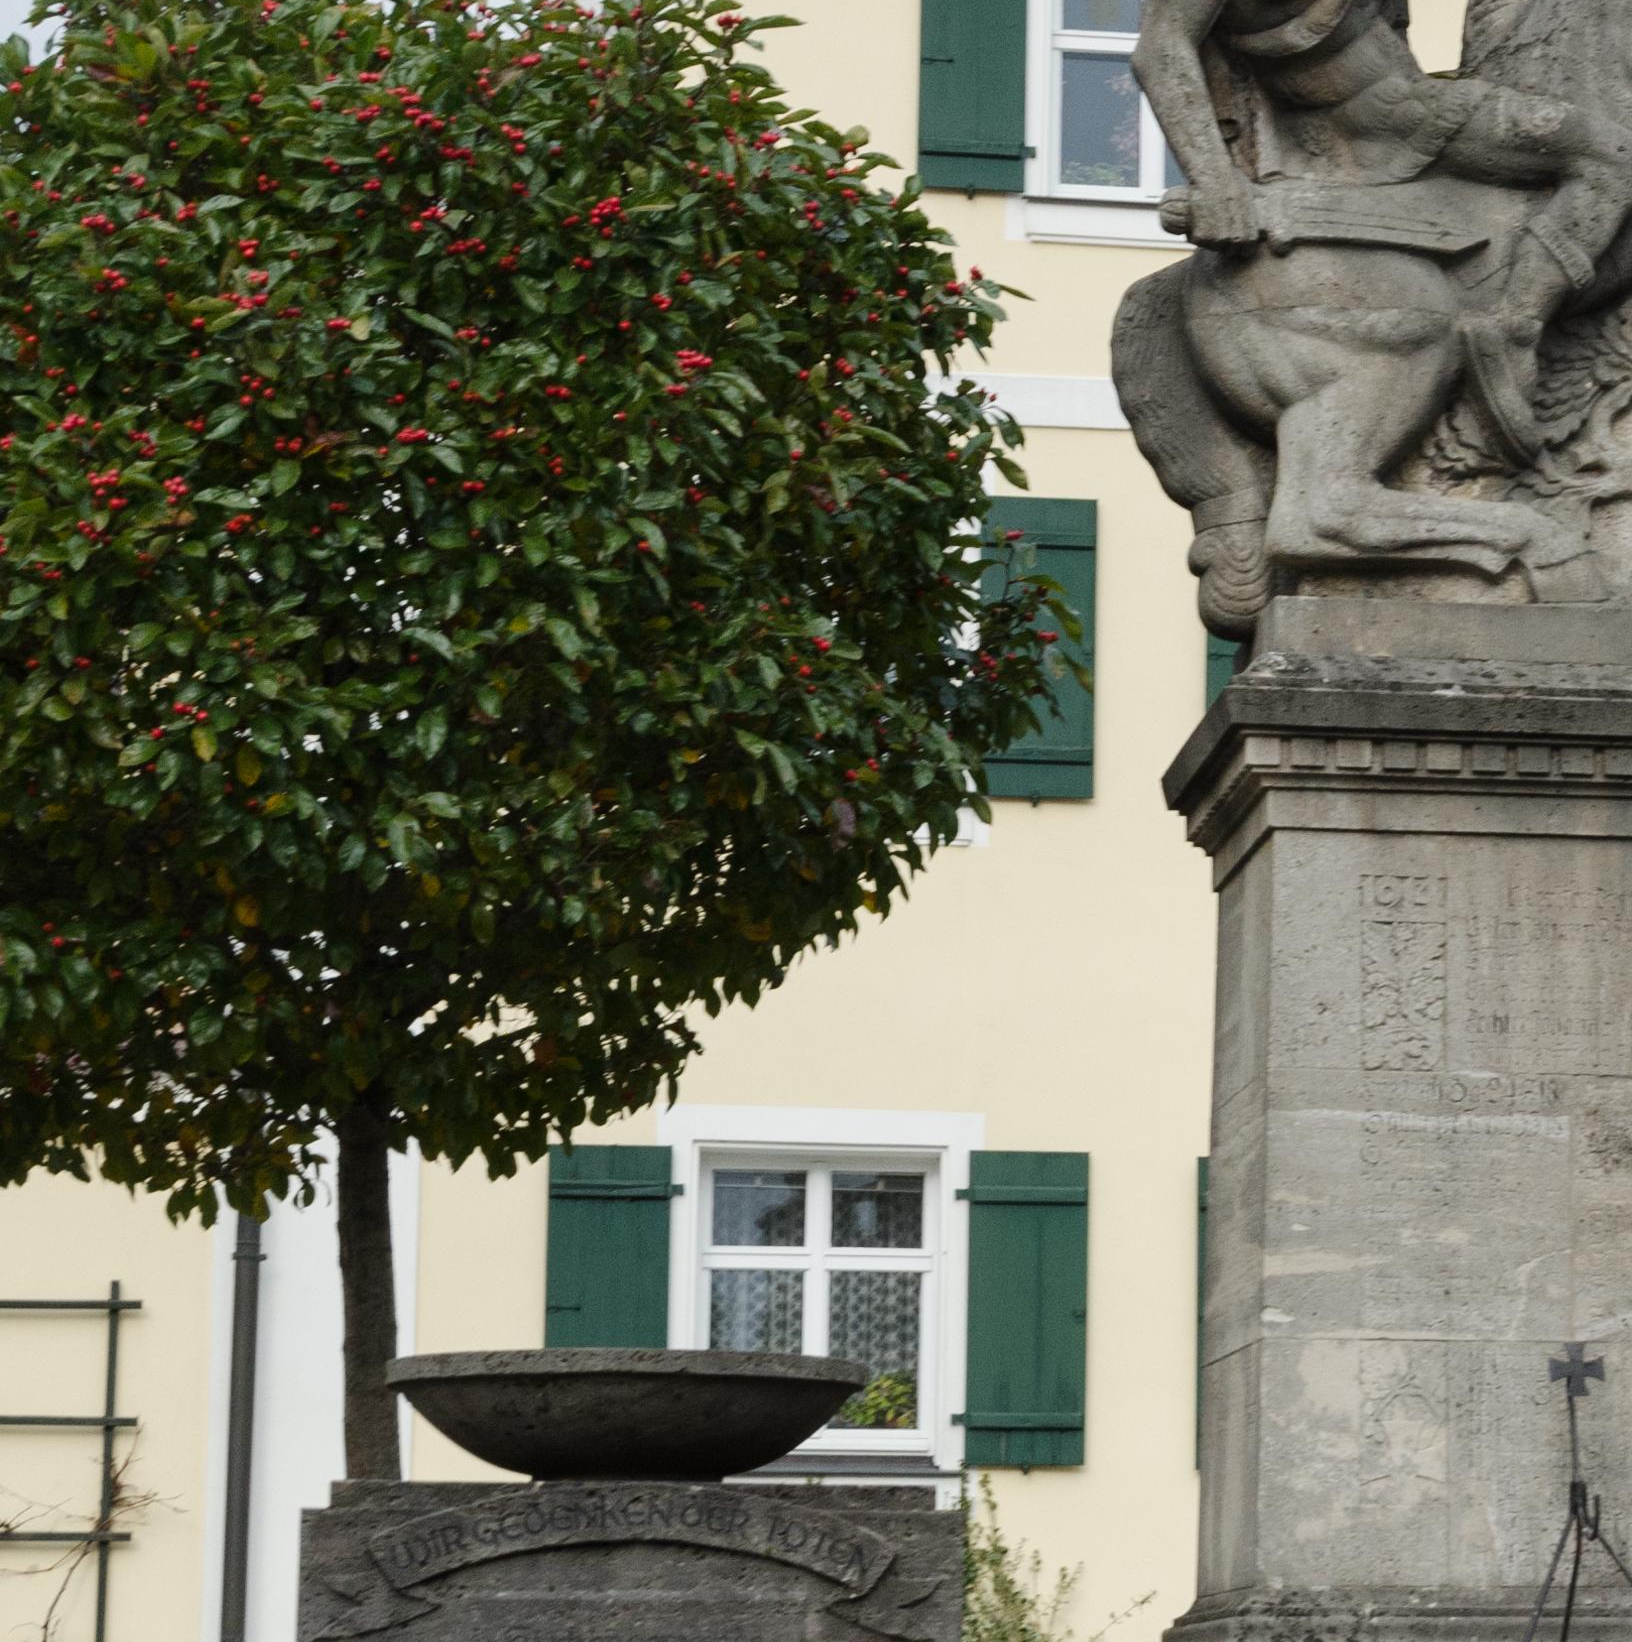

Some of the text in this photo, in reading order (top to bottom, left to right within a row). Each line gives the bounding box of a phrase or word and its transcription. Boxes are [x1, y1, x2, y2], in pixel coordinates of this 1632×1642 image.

[388, 1497, 877, 1579] WIR GEDENKEN DER TOTEN
